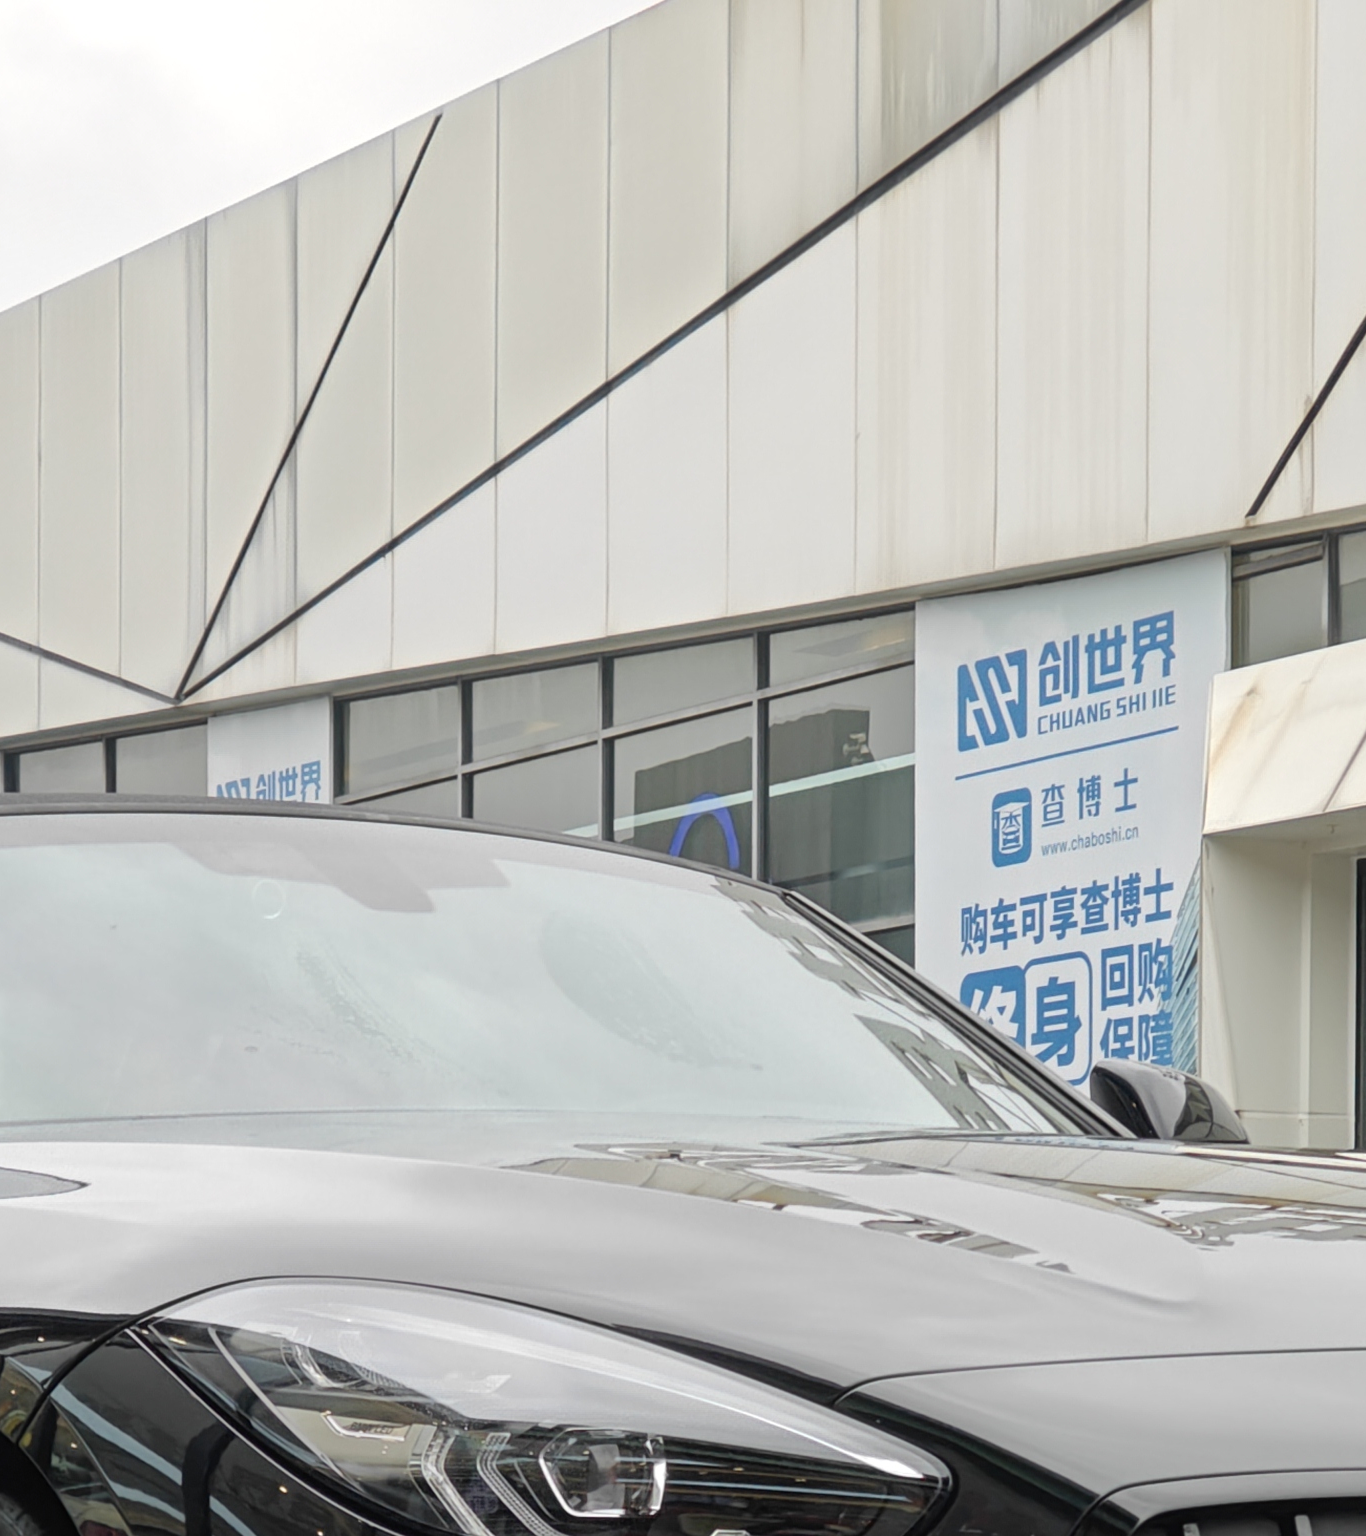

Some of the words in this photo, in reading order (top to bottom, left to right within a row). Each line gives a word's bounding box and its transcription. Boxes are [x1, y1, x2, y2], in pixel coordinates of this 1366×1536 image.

[1038, 610, 1176, 708] 创世界
[1037, 700, 1112, 736] CHUANG
[1116, 691, 1147, 718] SHI
[255, 760, 322, 803] 创世界
[1041, 767, 1139, 828] 查博士
[1041, 826, 1140, 857] www.chaboshi.cn
[960, 867, 1175, 958] 购车可享查博士
[1100, 938, 1175, 1012] 回购
[1099, 1008, 1175, 1068] 保障
